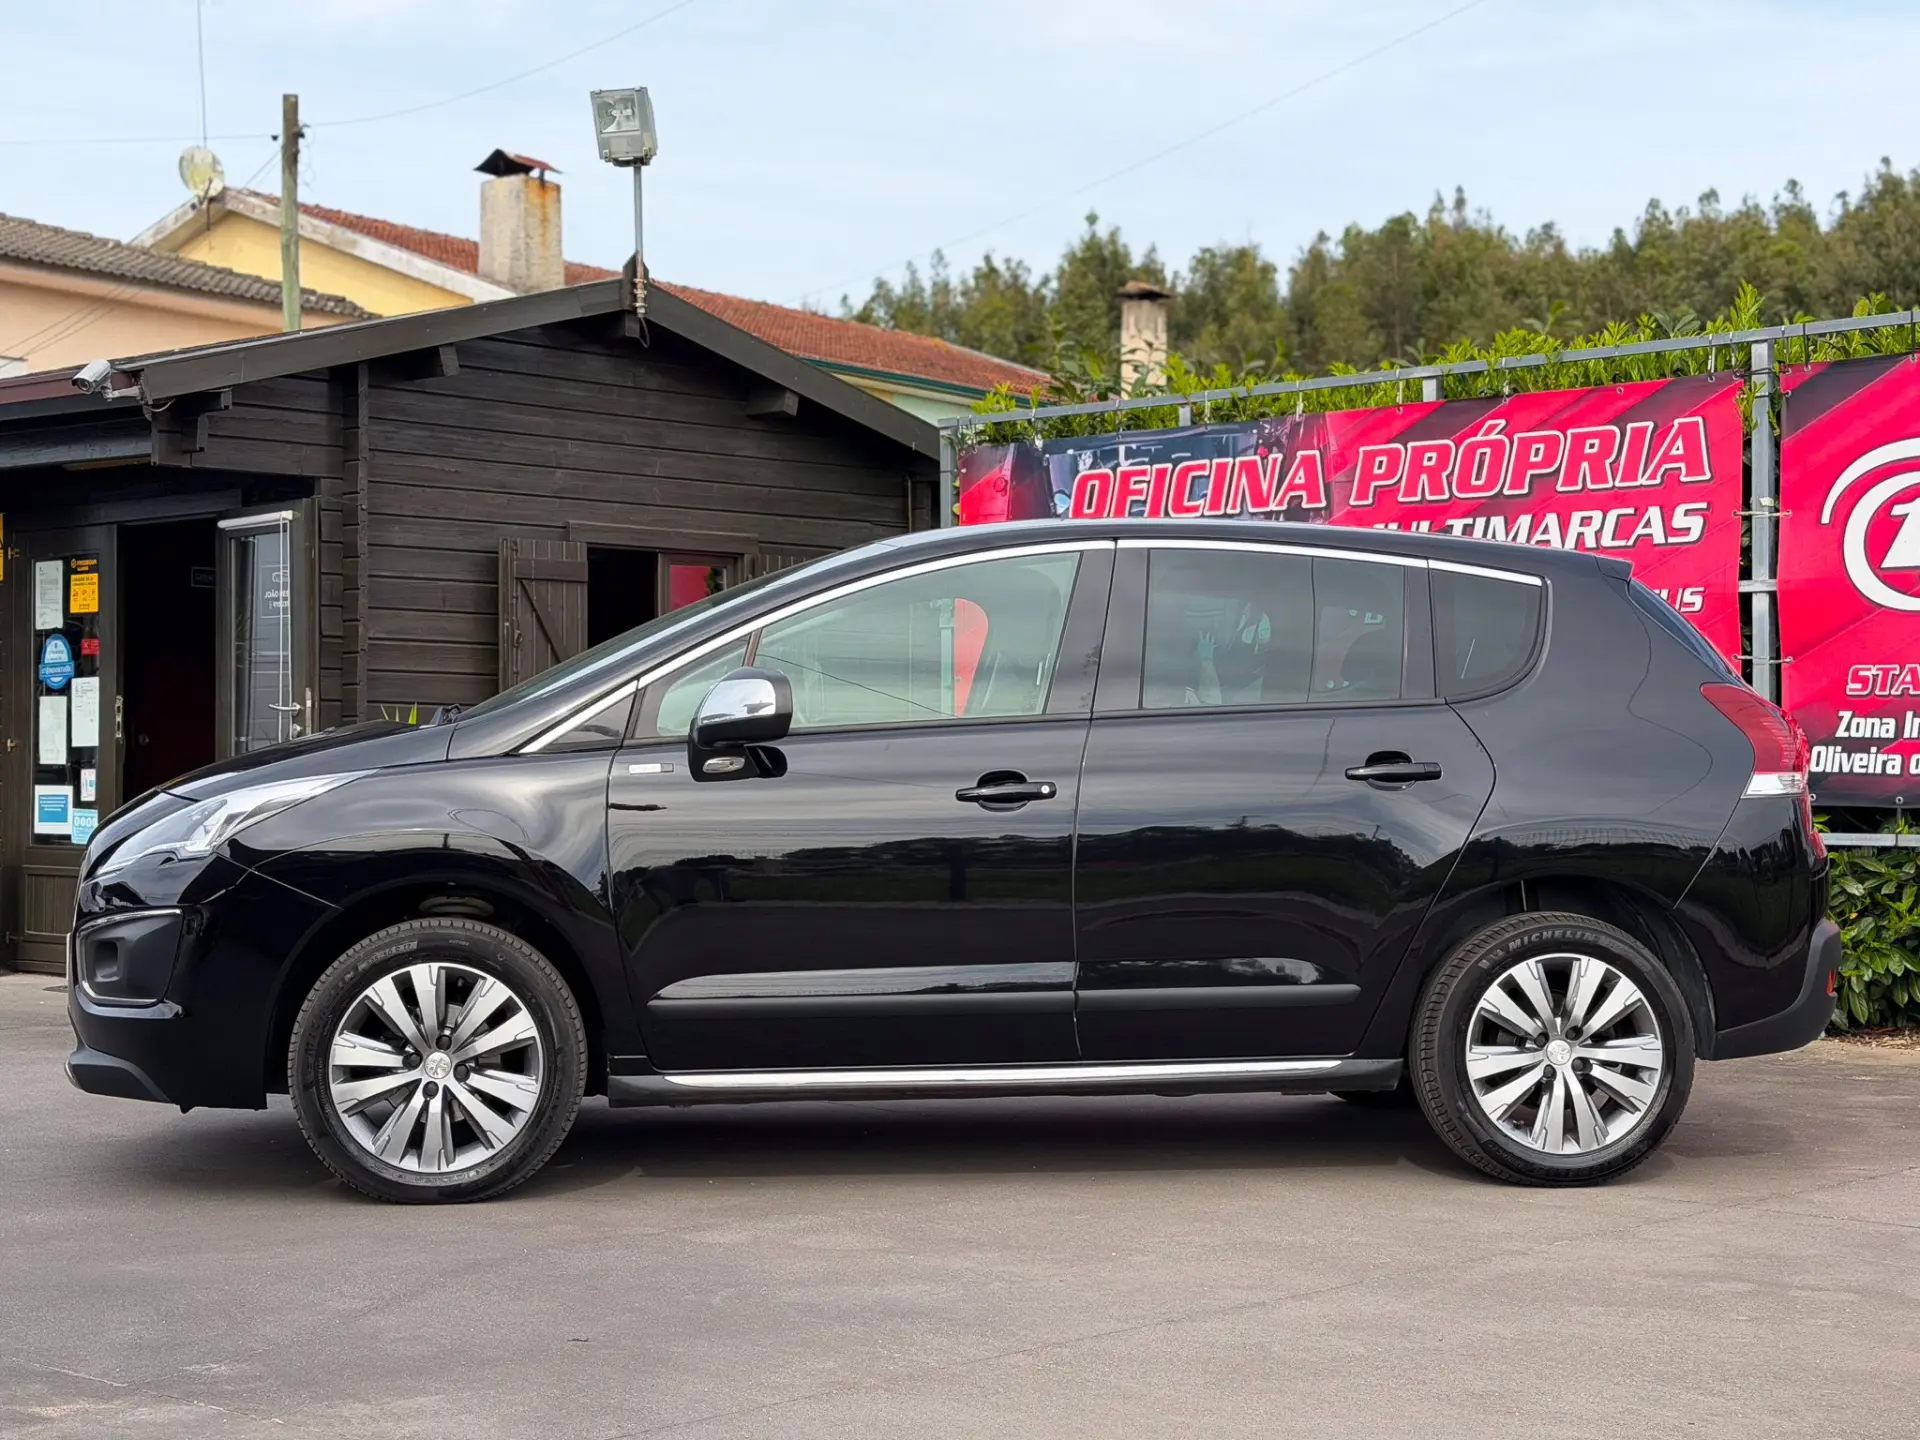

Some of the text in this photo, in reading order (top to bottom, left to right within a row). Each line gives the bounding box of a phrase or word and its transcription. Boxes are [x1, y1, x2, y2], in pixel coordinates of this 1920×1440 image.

[1069, 416, 1711, 518] OFICINA PRÓPRIA
[1834, 710, 1896, 738] Zona
[1809, 745, 1902, 775] Oliveira
[1508, 930, 1596, 952] MICHELIN
